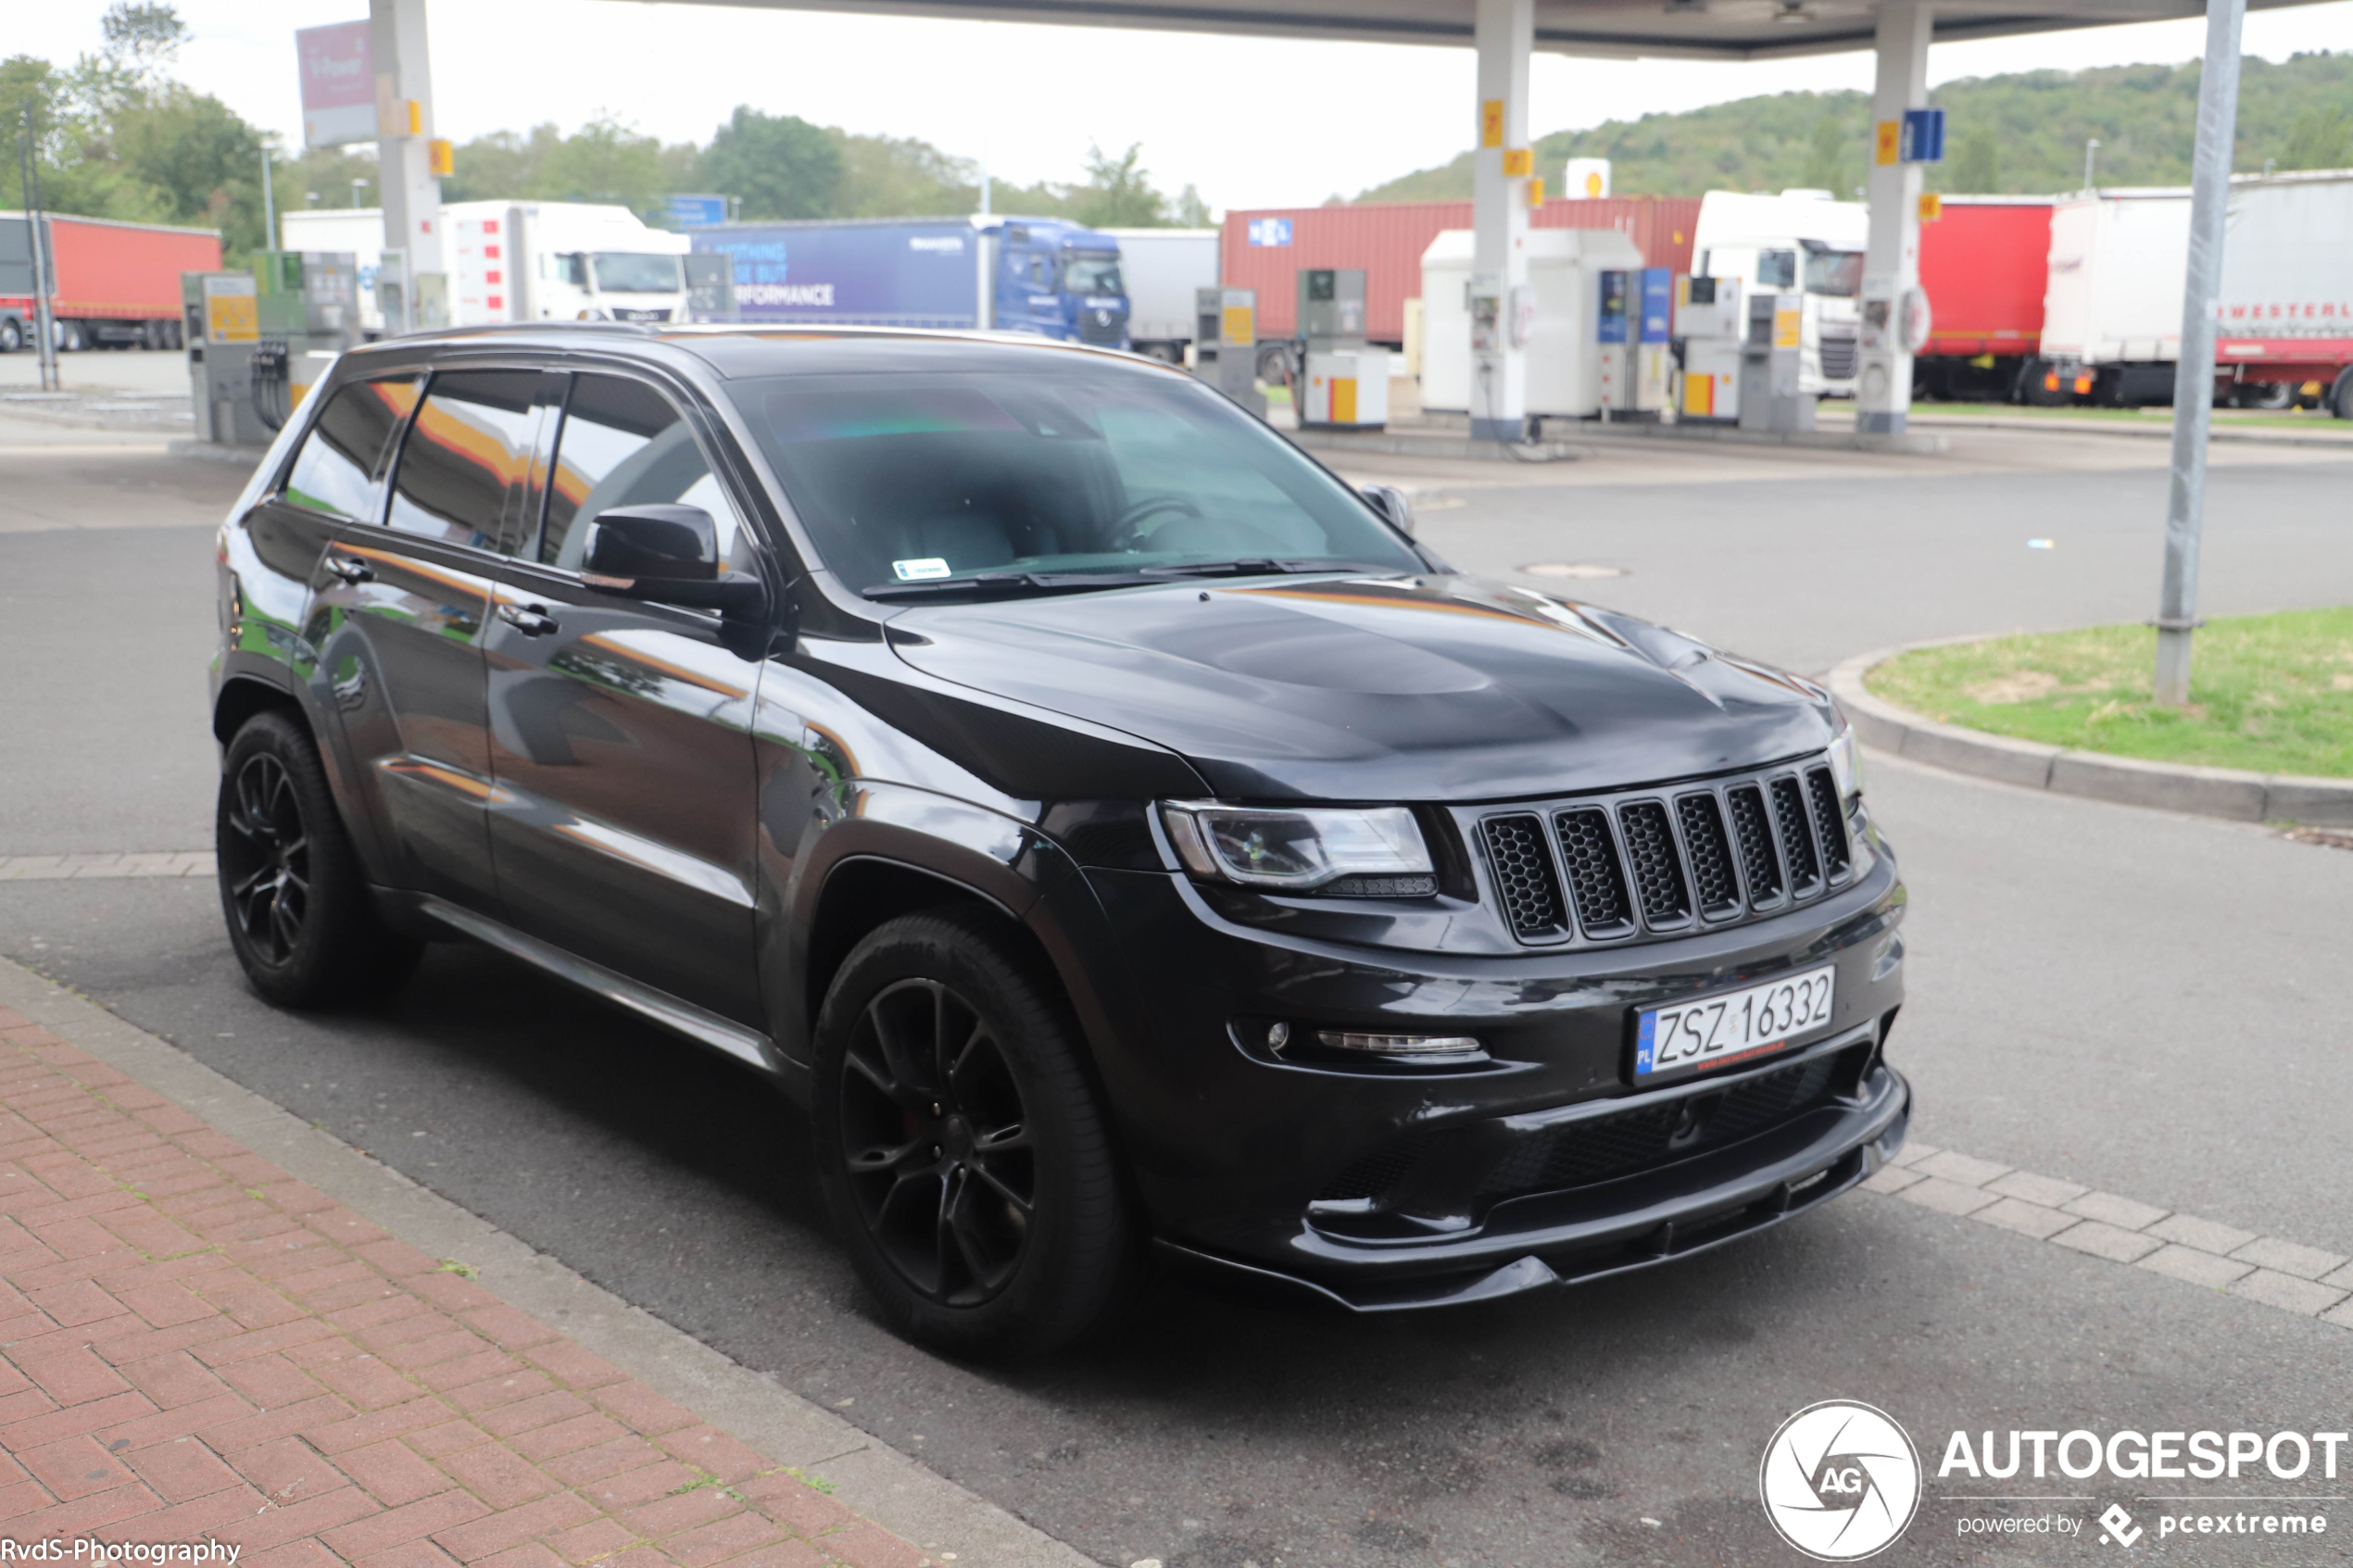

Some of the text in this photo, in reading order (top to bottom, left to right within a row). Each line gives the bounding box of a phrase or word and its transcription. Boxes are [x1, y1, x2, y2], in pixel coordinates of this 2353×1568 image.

[733, 283, 835, 307] RFORMANCE
[1656, 973, 1830, 1064] ZSZ 16332
[1637, 1049, 1651, 1064] PL
